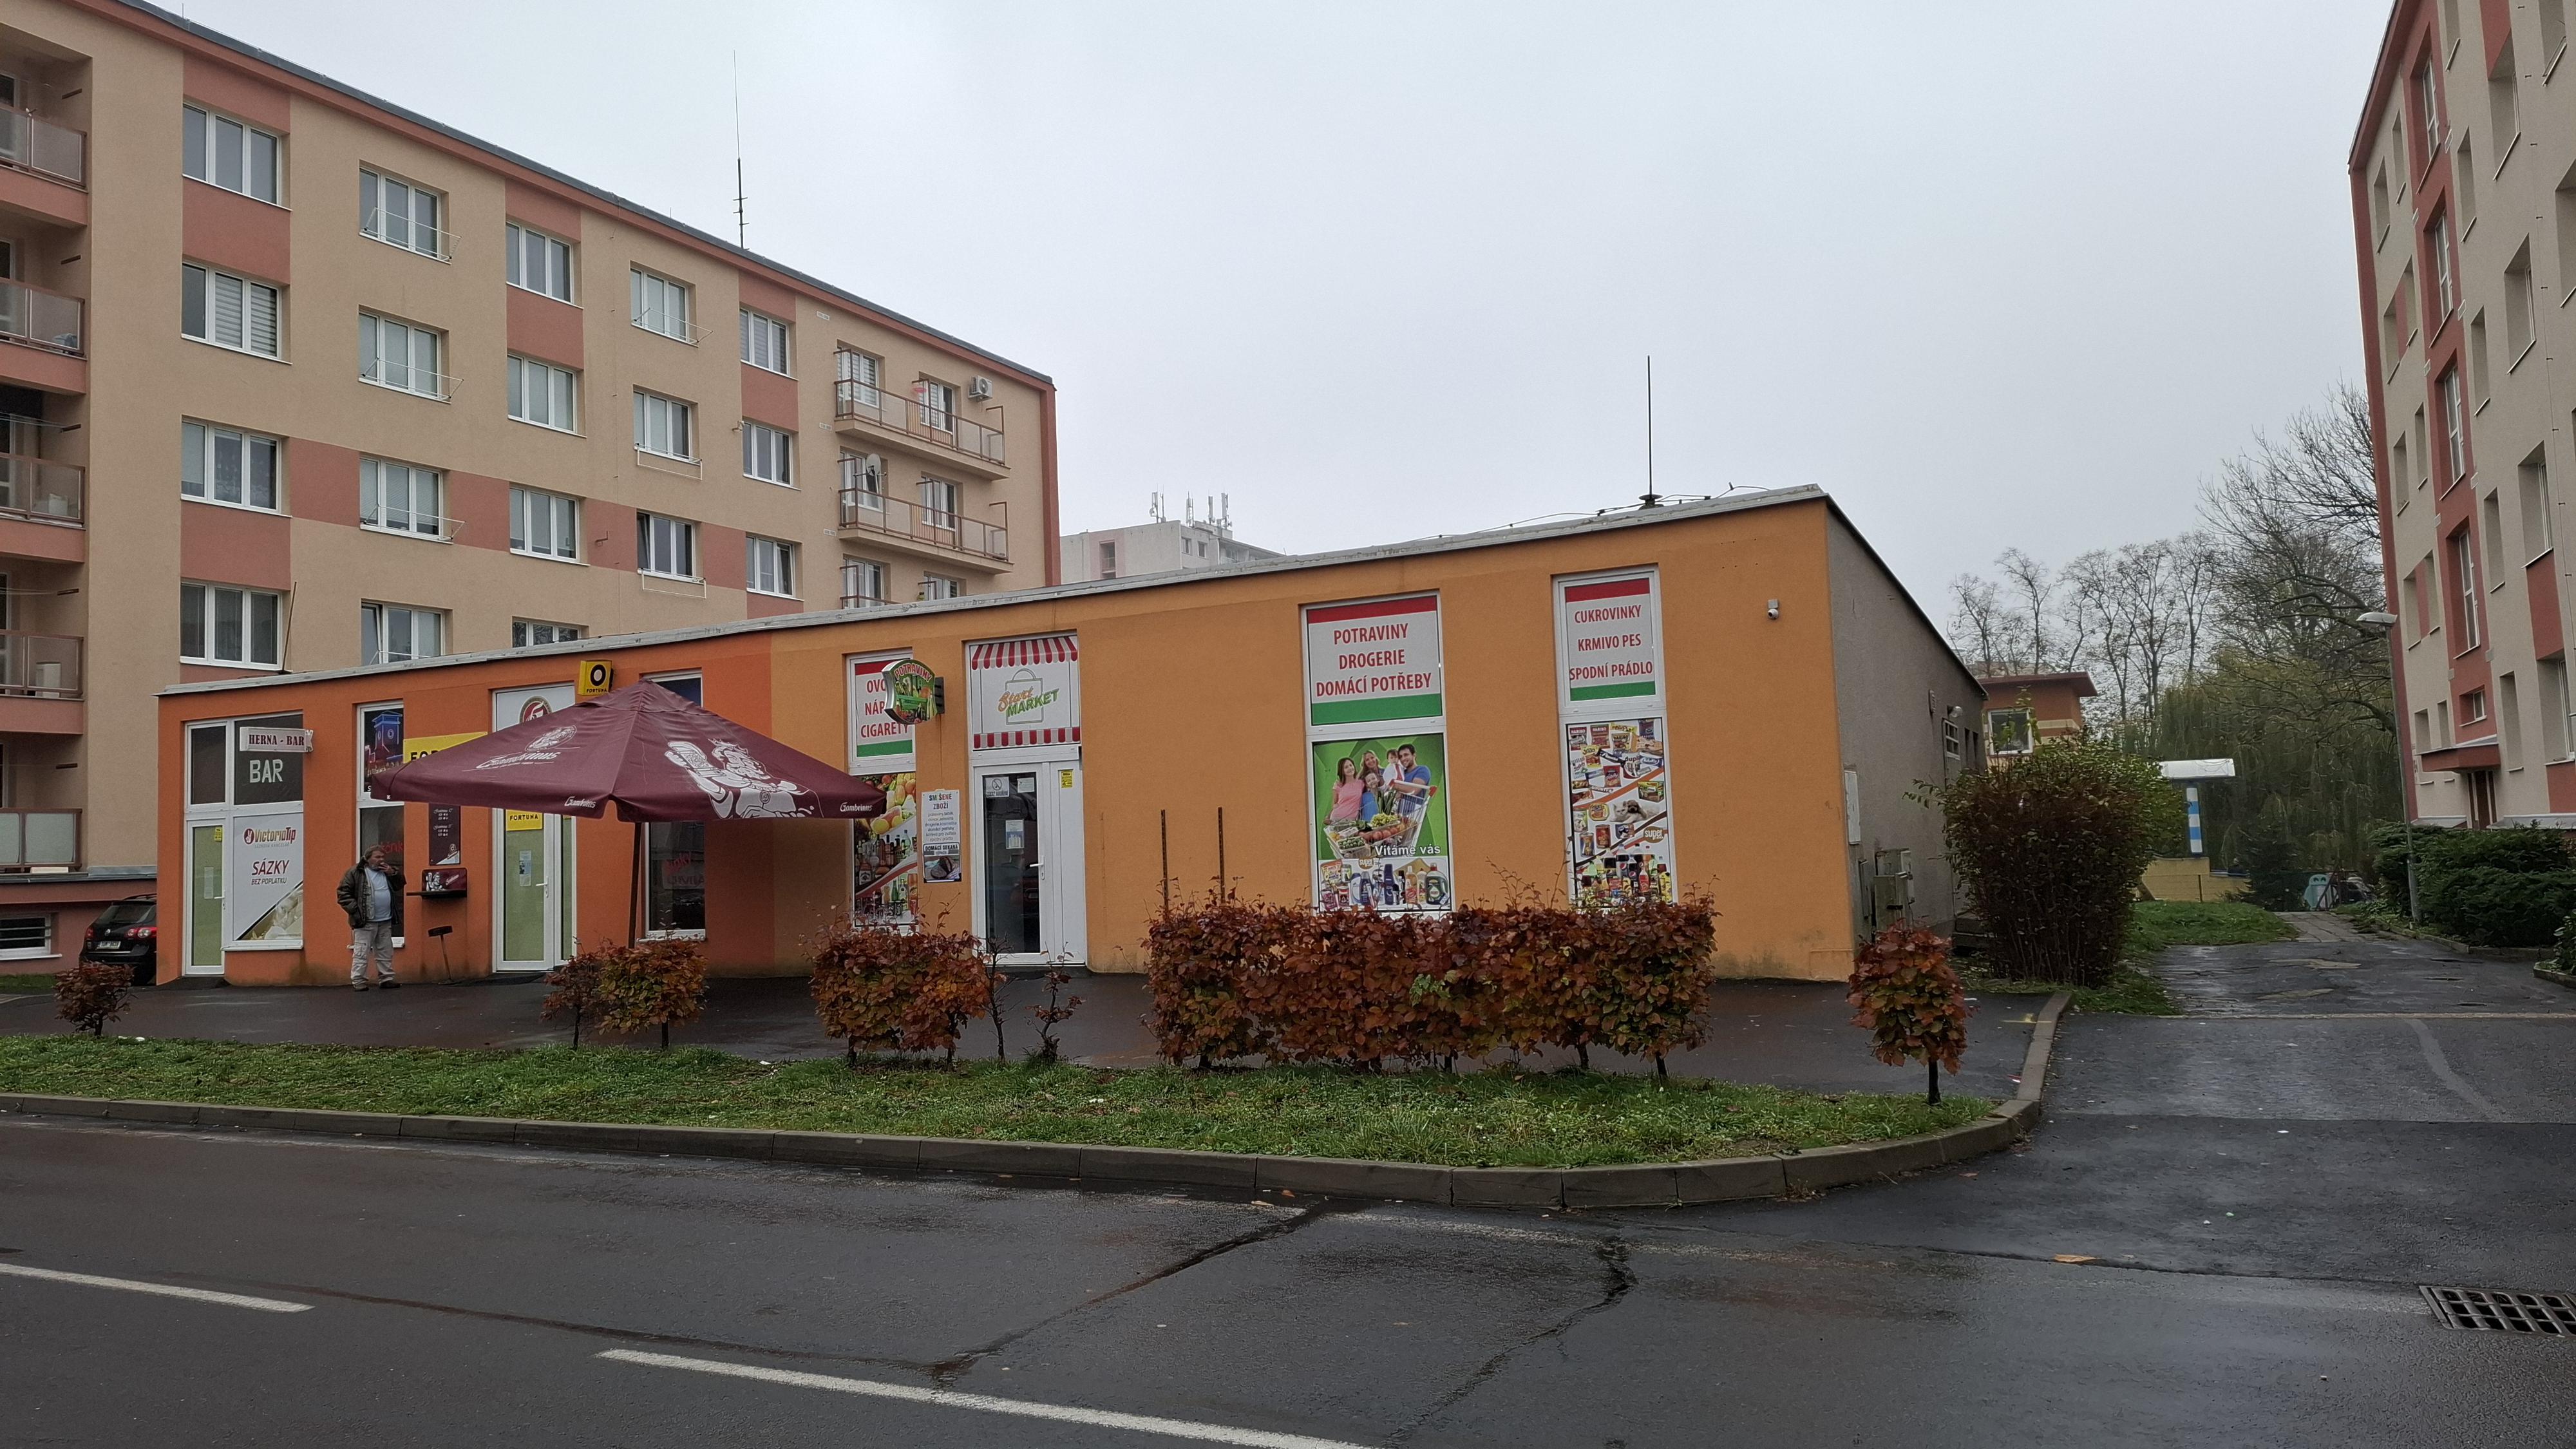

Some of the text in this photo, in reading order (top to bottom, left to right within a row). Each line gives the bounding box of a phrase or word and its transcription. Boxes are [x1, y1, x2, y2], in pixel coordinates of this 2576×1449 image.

[1575, 605, 1642, 623] CUKROVINKY
[1334, 623, 1408, 645] POTRAVINY
[1578, 633, 1642, 651] KRMIVO PES
[1339, 649, 1405, 670] DROGERIE
[895, 663, 932, 681] POTRAVINY
[1569, 660, 1653, 680] SPODNÍ PRÁDLO
[1316, 672, 1432, 697] DOMÁCÍ POTŘEBY
[1006, 688, 1059, 717] MARKET
[860, 721, 909, 738] CIGARETY
[249, 735, 277, 745] HERNA
[287, 736, 304, 746] BAR
[250, 759, 283, 783] BAR
[840, 802, 873, 812] Gambrinus
[933, 801, 949, 810] ZBOŽÍ
[1645, 829, 1663, 840] super
[1374, 844, 1441, 856] Vítáme vás
[252, 858, 289, 876] SÁZKY
